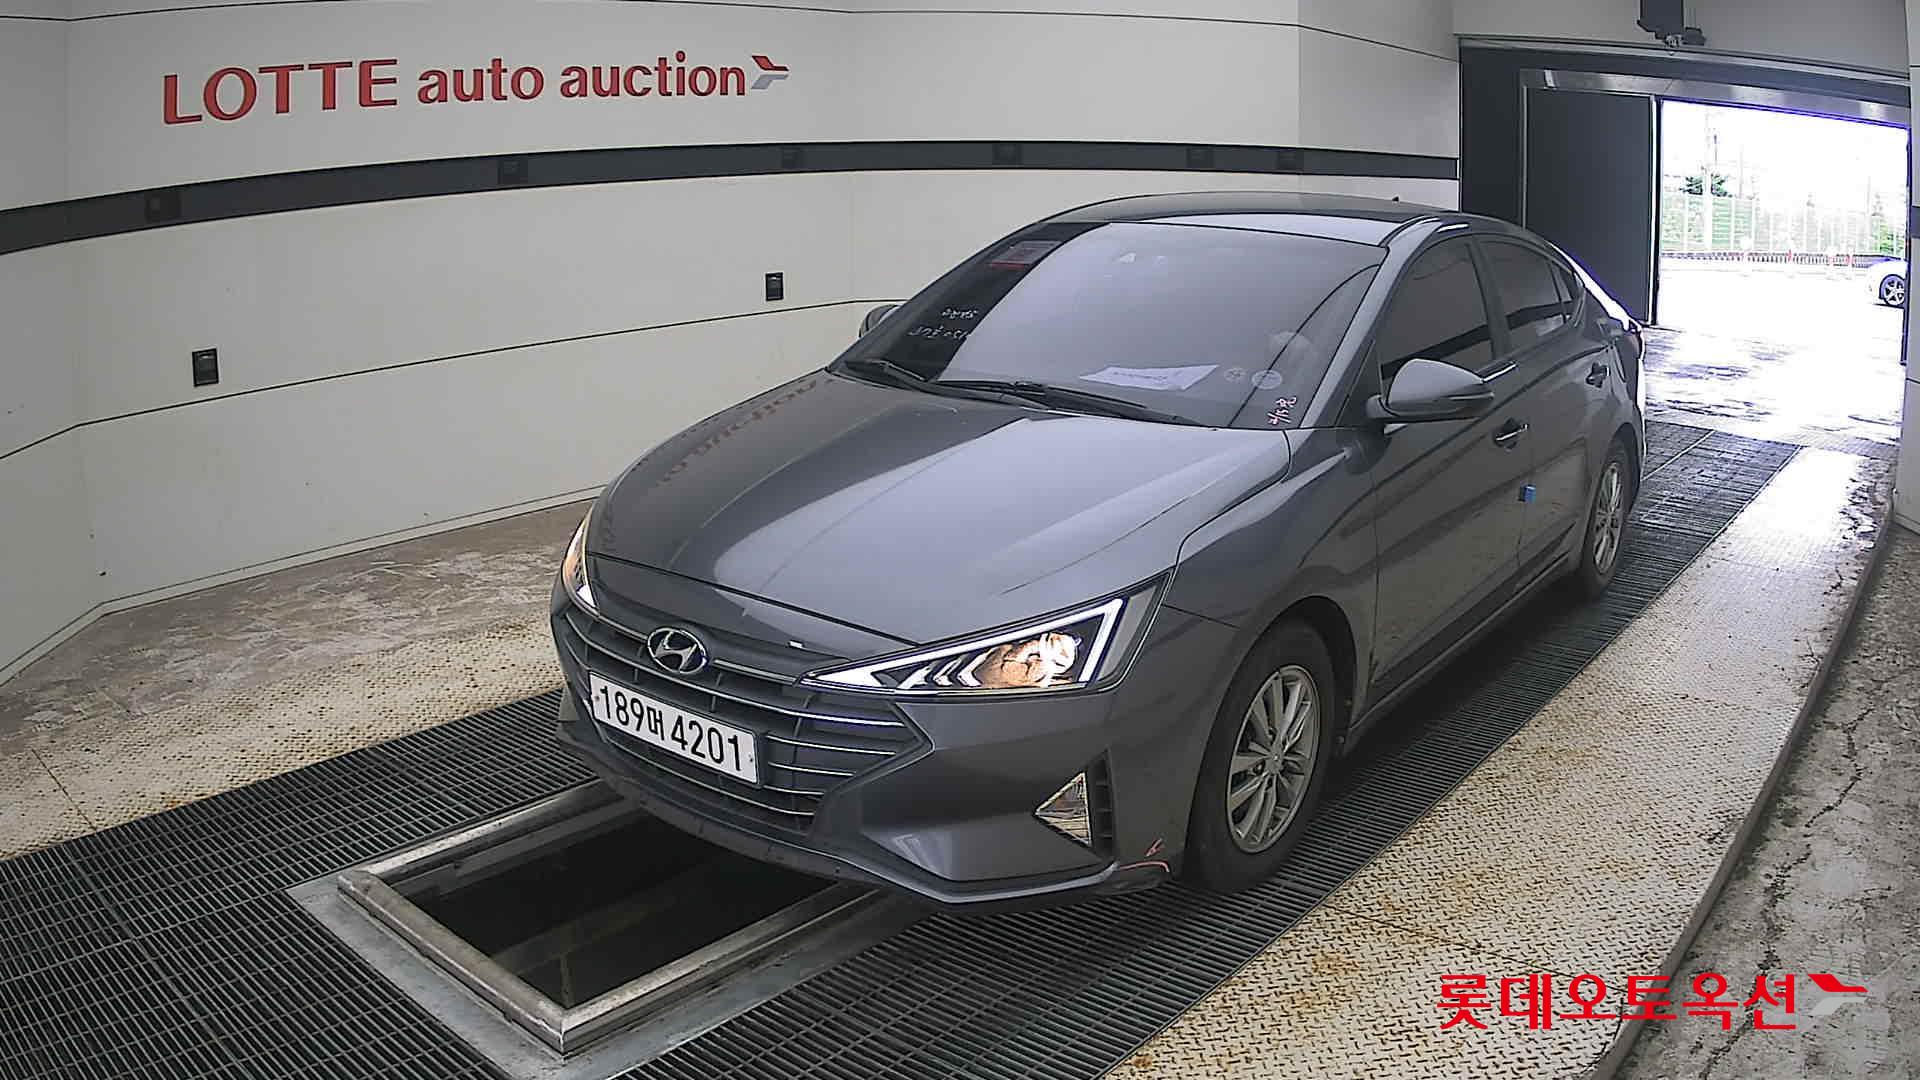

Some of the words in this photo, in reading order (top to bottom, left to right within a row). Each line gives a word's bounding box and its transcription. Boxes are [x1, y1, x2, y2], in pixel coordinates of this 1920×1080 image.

[163, 58, 398, 125] LOTTE
[417, 57, 545, 105] auto
[560, 50, 747, 99] auction
[670, 715, 742, 772] 4201
